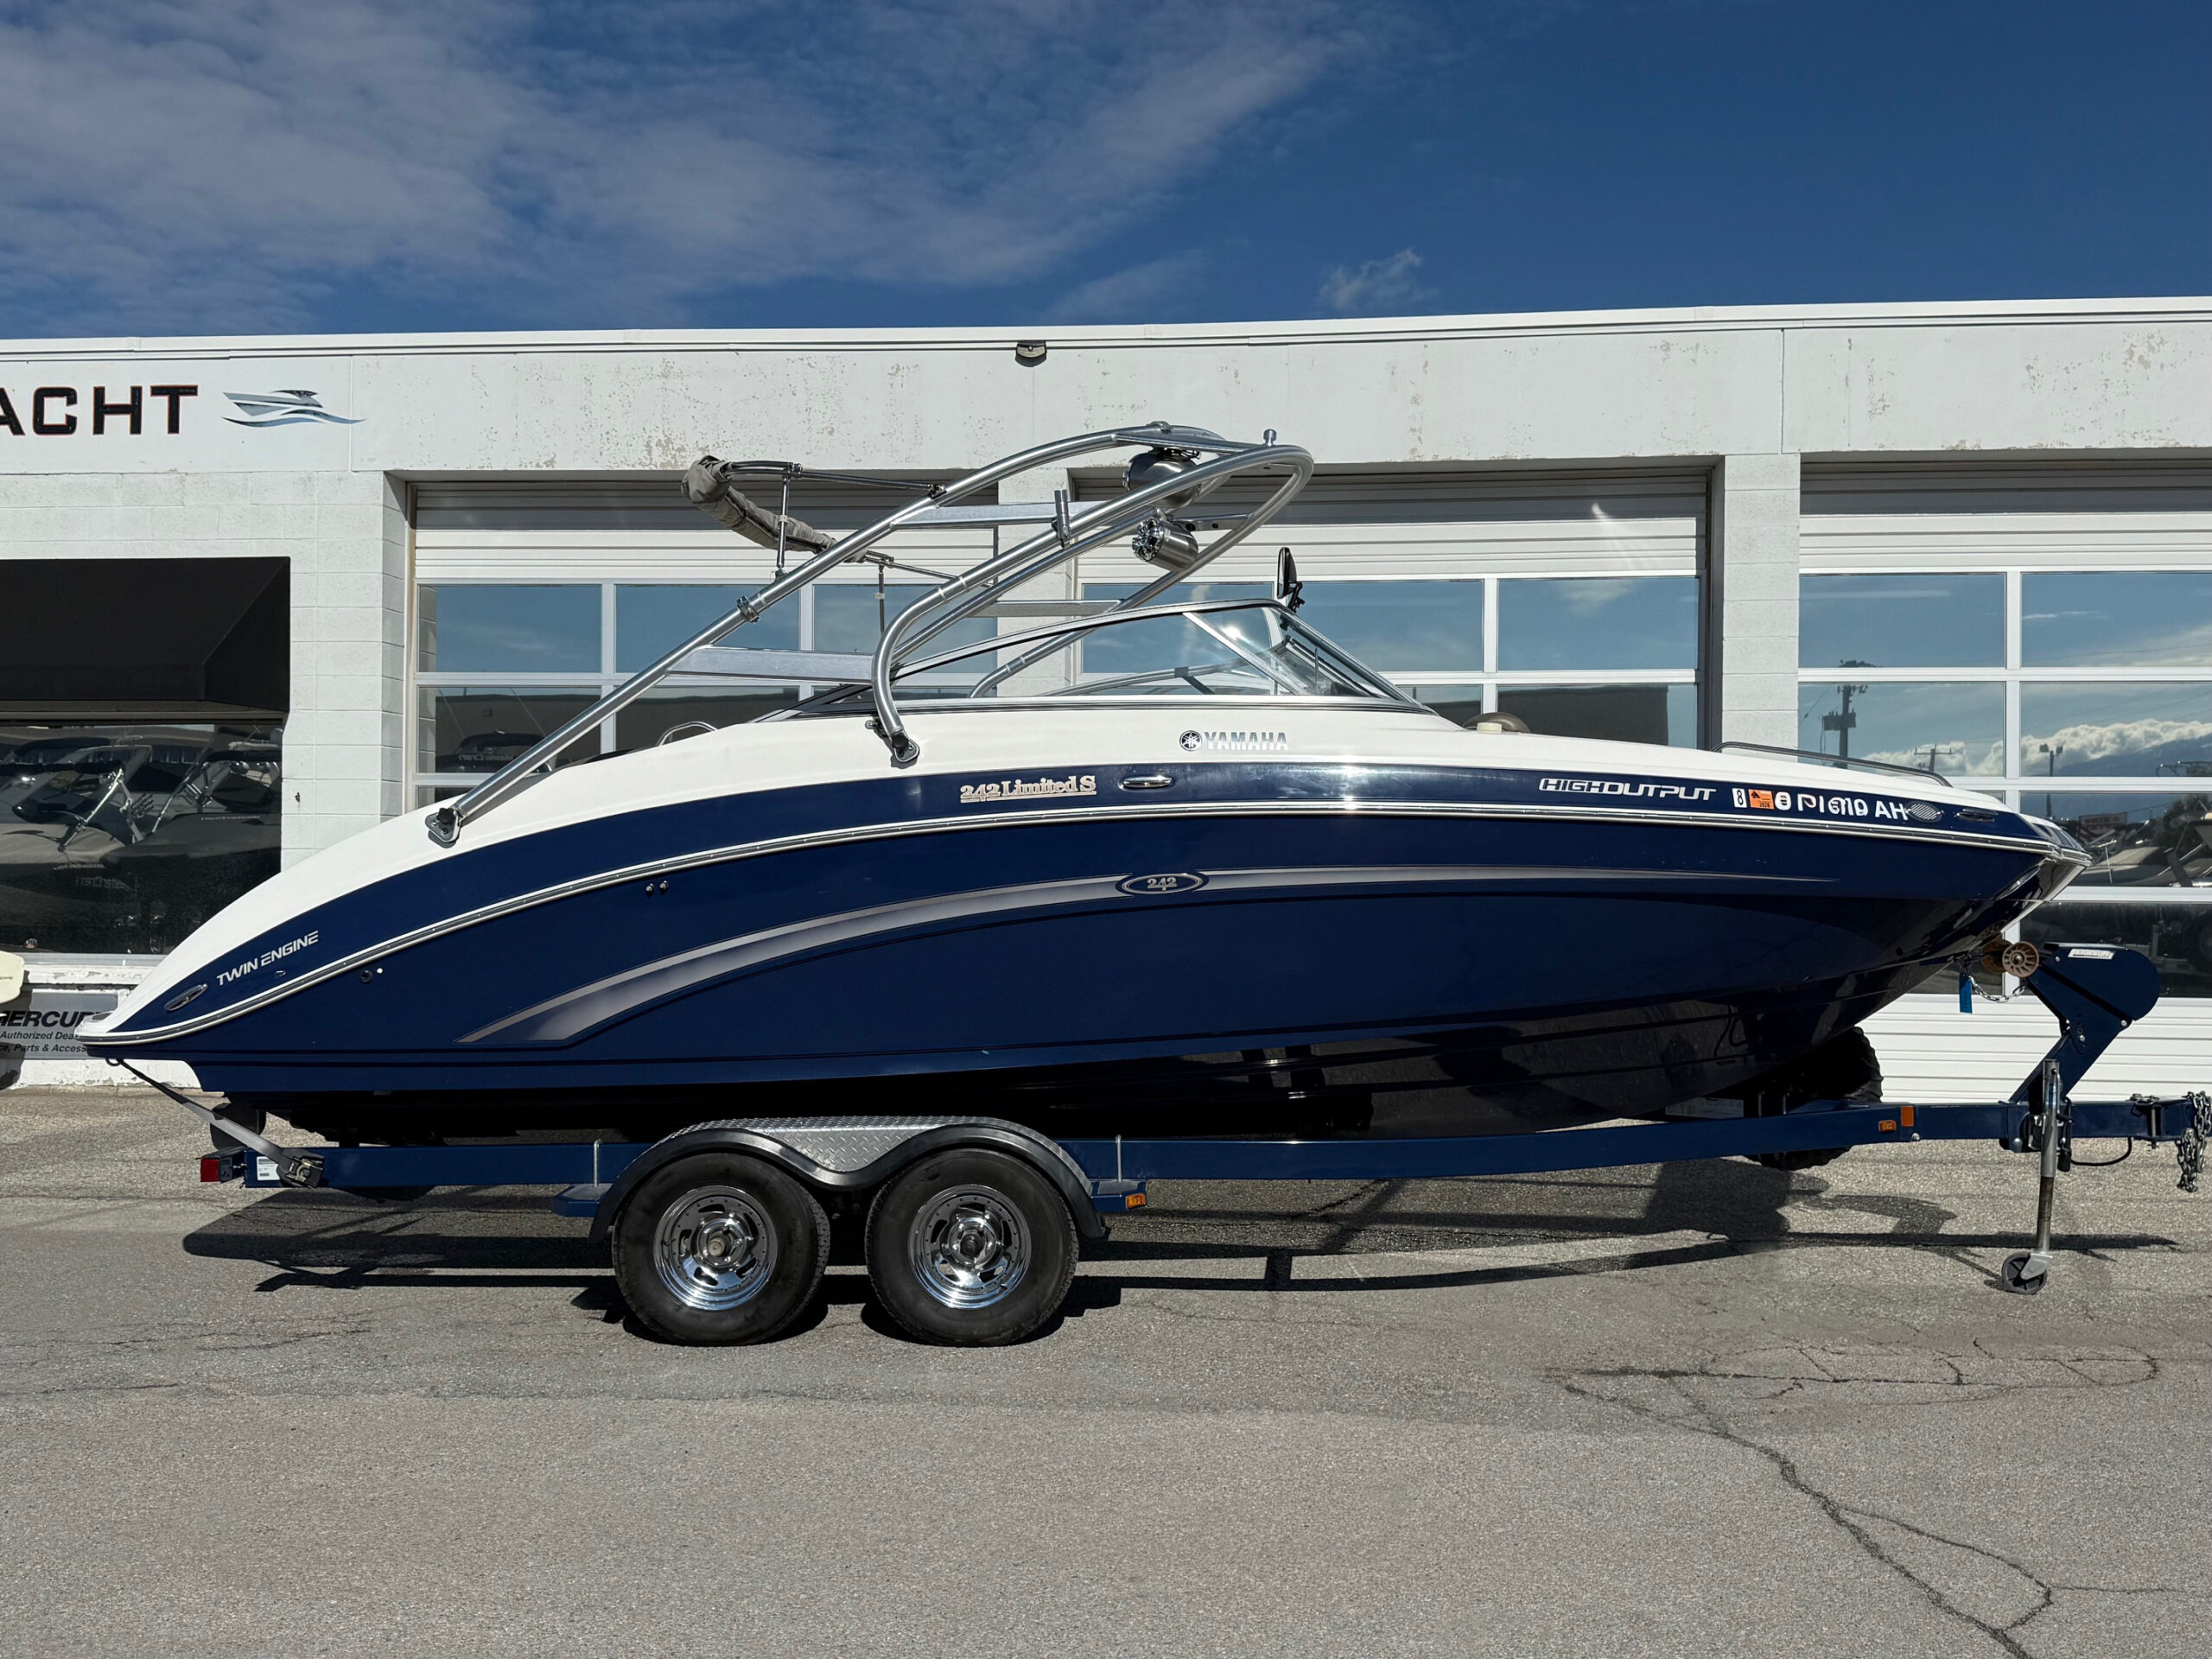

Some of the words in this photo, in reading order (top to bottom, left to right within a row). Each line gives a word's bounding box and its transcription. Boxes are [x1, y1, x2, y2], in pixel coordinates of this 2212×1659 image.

[1204, 731, 1289, 751] YAMAHA
[960, 784, 1001, 802] 242
[1001, 775, 1077, 797] Limited
[1079, 775, 1097, 791] S
[1147, 876, 1178, 891] 242
[216, 957, 258, 986] TWIN
[260, 930, 319, 967] ENGINE
[1, 1031, 54, 1040] Authorized
[54, 1032, 76, 1040] Dea
[14, 1043, 40, 1052] Parts
[42, 1044, 49, 1052] &
